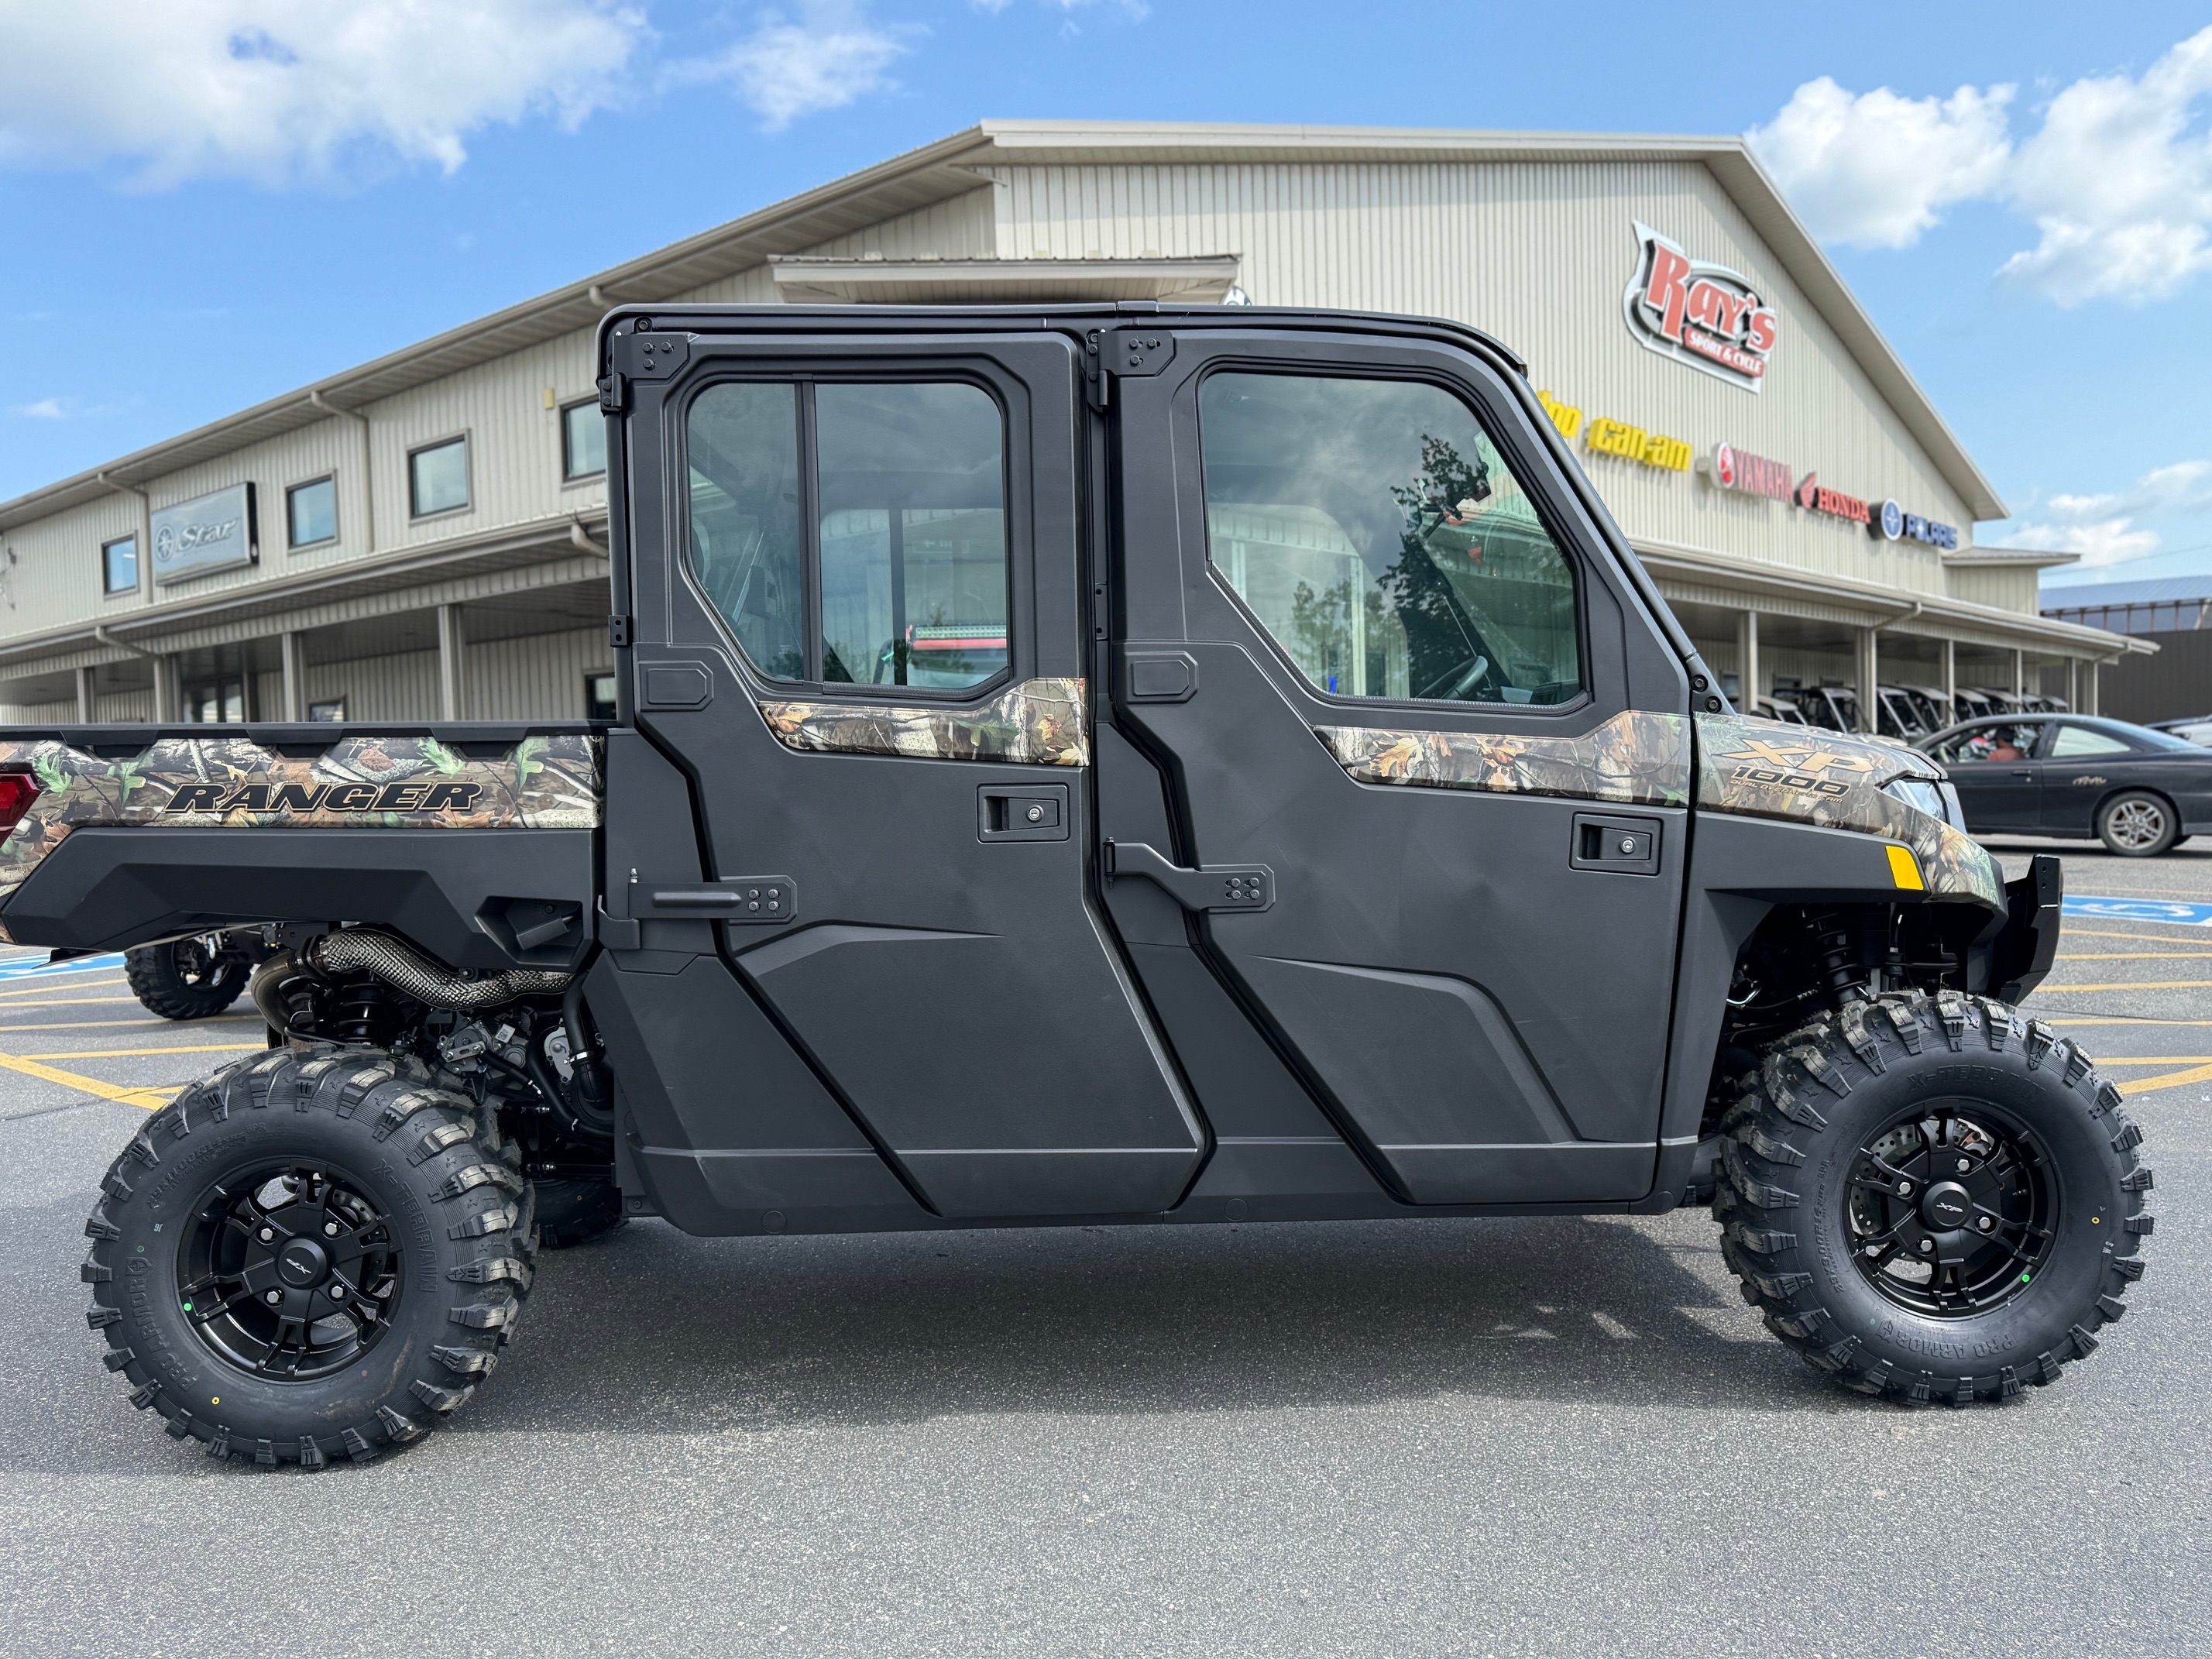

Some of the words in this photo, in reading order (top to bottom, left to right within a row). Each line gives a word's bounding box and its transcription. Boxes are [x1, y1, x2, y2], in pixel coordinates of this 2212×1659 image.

[1644, 239, 1777, 353] Ray's
[1689, 331, 1723, 357] SPORT
[1723, 348, 1735, 362] &
[1733, 352, 1763, 373] CYCLE
[1733, 448, 1794, 503] YAMAHA
[1817, 486, 1871, 524] HONDA
[177, 517, 240, 553] Star
[1713, 738, 1875, 772] XP
[162, 782, 483, 812] RANGER
[1729, 779, 1758, 788] DUAL
[1760, 783, 1819, 799] OVERHEAD
[1819, 795, 1843, 804] CAM
[1730, 764, 1851, 799] 1000
[371, 1158, 438, 1292] X-TERRAIN
[1936, 1202, 1963, 1213] XP
[129, 1279, 170, 1352] ARMOR
[1895, 1329, 1968, 1360] ARMOR
[1973, 1332, 2018, 1358] PRO
[158, 1352, 199, 1392] PRO
